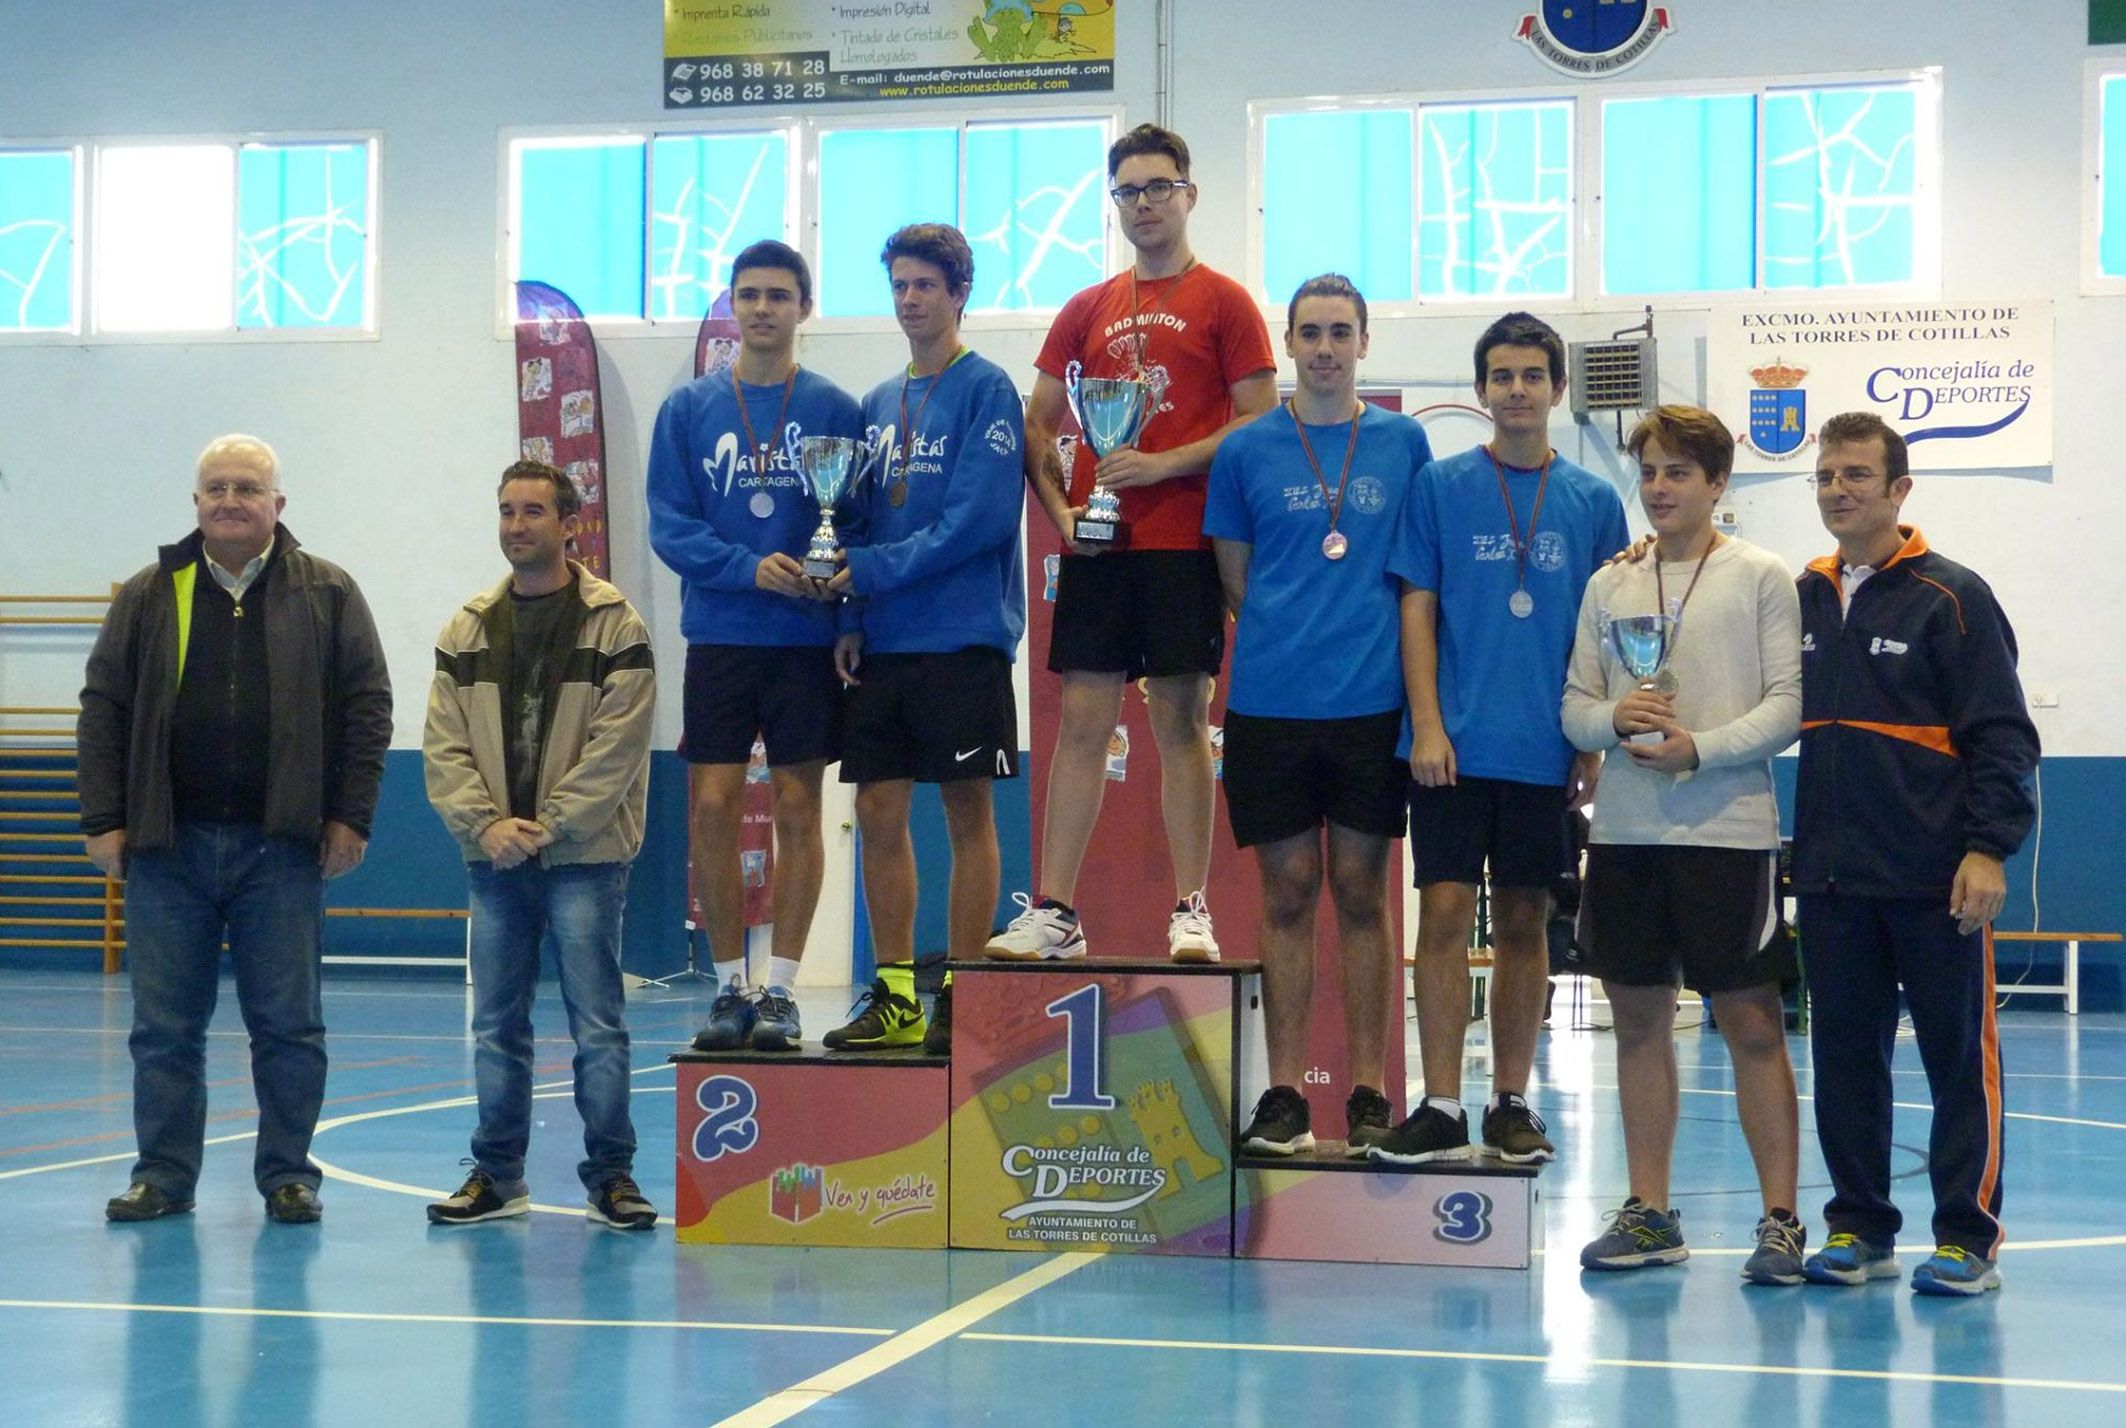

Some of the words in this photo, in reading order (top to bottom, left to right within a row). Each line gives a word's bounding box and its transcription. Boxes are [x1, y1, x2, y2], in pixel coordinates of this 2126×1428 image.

[682, 7, 729, 21] Imprenta
[840, 4, 892, 20] Impresión
[895, 1, 931, 17] Digital
[886, 29, 900, 42] de
[904, 26, 959, 41] Cristales
[700, 63, 734, 80] 968
[741, 62, 764, 78] 38
[771, 60, 793, 77] 71
[802, 59, 825, 75] 28
[1547, 50, 1590, 70] TORRES
[1595, 60, 1610, 70] DE
[894, 65, 1110, 83] duende@rotulacionesduende.com
[700, 86, 734, 103] 968
[742, 85, 765, 101] 62
[773, 84, 795, 100] 32
[803, 82, 826, 98] 25
[880, 79, 1069, 97] www.rotulacionesduende.com
[1742, 313, 1819, 327] EXCMO.
[1827, 308, 1986, 325] AYUNTAMIENTO
[1992, 307, 2019, 321] DE
[1750, 331, 1787, 345] LAS
[1791, 330, 1871, 344] TORRES
[1876, 329, 1903, 342] DE
[1908, 326, 2010, 341] COTILLAS
[1866, 359, 2000, 403] Concejalía
[2007, 359, 2034, 378] de
[1899, 385, 2031, 420] DEPORTES
[875, 423, 948, 488] Maistas
[738, 475, 800, 488] CARTAGEN
[1045, 984, 1115, 1110] 1
[1304, 1067, 1330, 1084] cia
[693, 1075, 759, 1162] 2
[1002, 1145, 1121, 1176] Concejalía
[1127, 1146, 1149, 1163] de
[1032, 1164, 1166, 1198] DEPORTES
[826, 1181, 853, 1208] Ven
[859, 1191, 869, 1212] y
[876, 1175, 935, 1207] quédate
[1029, 1217, 1117, 1230] AYUNTAMIENTO
[1120, 1219, 1136, 1230] DE
[1437, 1190, 1488, 1243] 3
[1008, 1229, 1030, 1240] LAS
[1032, 1230, 1079, 1241] TORRES
[1082, 1231, 1098, 1241] DE
[1100, 1232, 1157, 1244] COTILLAS
